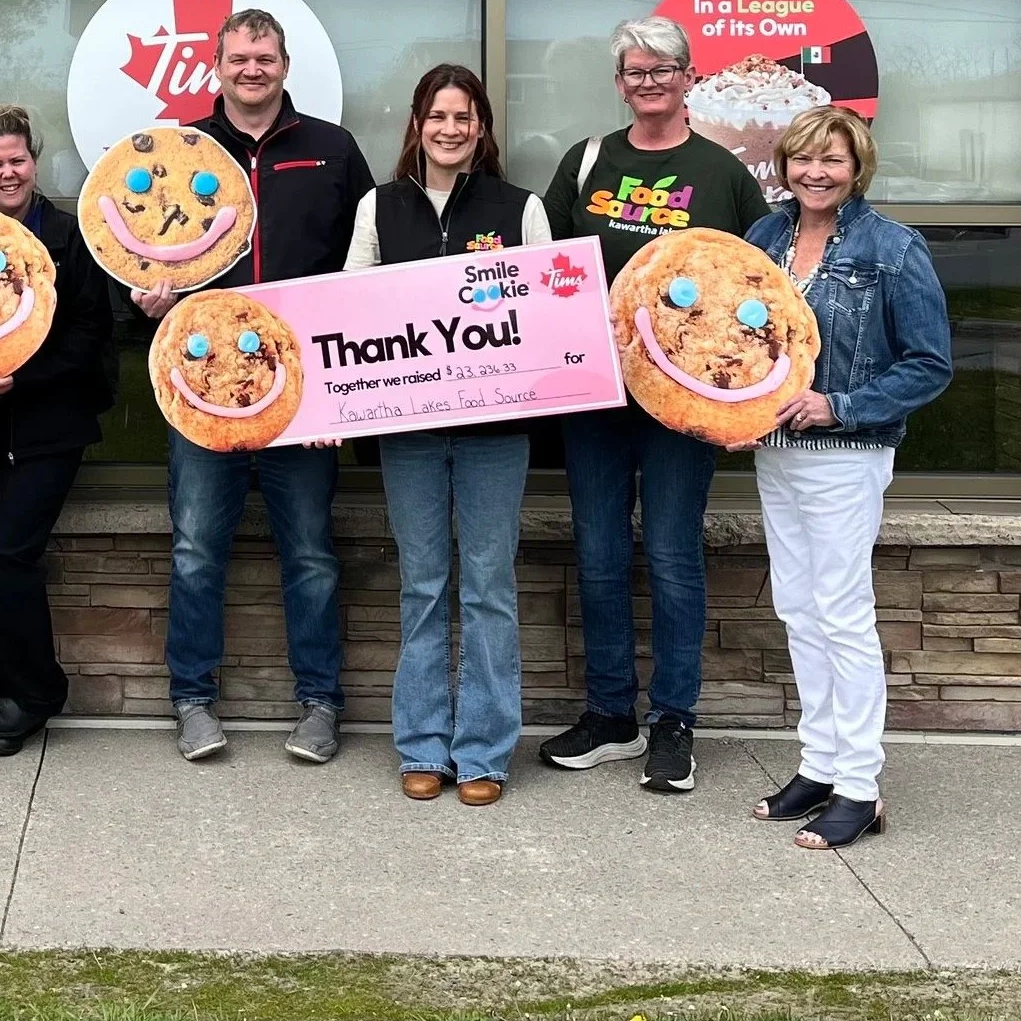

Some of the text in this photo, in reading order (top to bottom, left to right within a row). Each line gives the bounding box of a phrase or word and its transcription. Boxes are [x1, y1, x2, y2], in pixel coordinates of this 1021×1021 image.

[718, 0, 732, 14] a
[702, 17, 808, 36] of its Own
[617, 175, 694, 210] Food
[585, 189, 691, 228] Source
[608, 219, 658, 235] kawartha
[466, 240, 504, 251] Source
[475, 234, 502, 245] Food
[464, 261, 520, 284] Smile
[543, 267, 585, 289] Tims
[458, 279, 530, 304] Cookie
[311, 309, 522, 369] Thank You!
[564, 352, 586, 365] for
[324, 368, 442, 396] Together we raised
[337, 400, 403, 423] Kawartha
[457, 388, 486, 409] Food
[494, 387, 538, 405] Source
